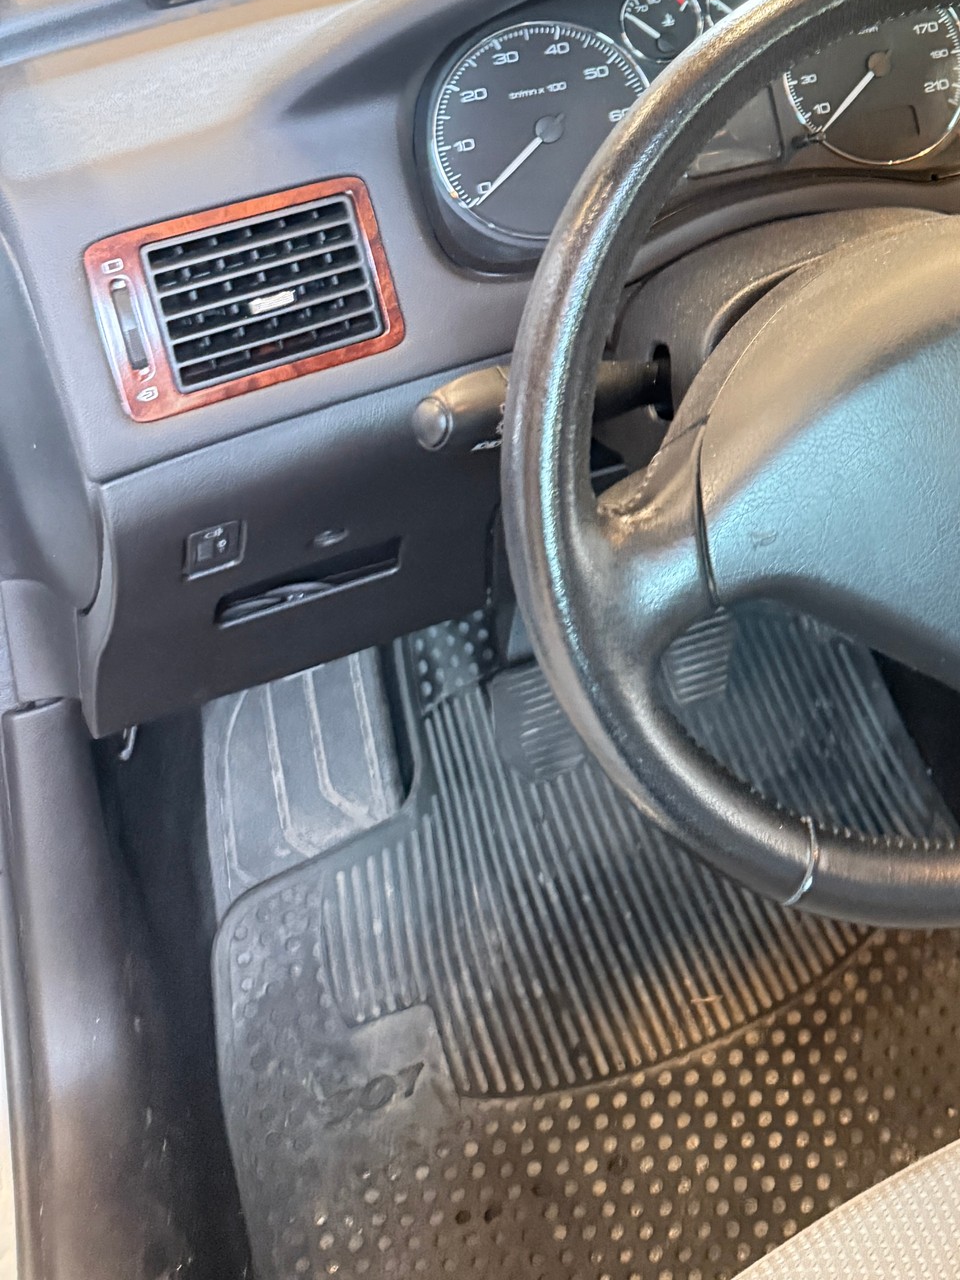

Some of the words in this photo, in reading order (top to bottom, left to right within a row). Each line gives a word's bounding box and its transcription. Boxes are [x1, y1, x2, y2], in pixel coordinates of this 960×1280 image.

[912, 21, 939, 35] 170
[543, 41, 570, 55] 40
[929, 49, 949, 60] 190
[491, 50, 519, 66] 30
[582, 65, 609, 81] 50
[800, 73, 817, 85] 30
[546, 80, 567, 93] 100
[923, 78, 950, 94] 210
[459, 87, 488, 104] 20
[813, 102, 831, 115] 10
[453, 138, 476, 153] 10
[476, 181, 493, 195] 0
